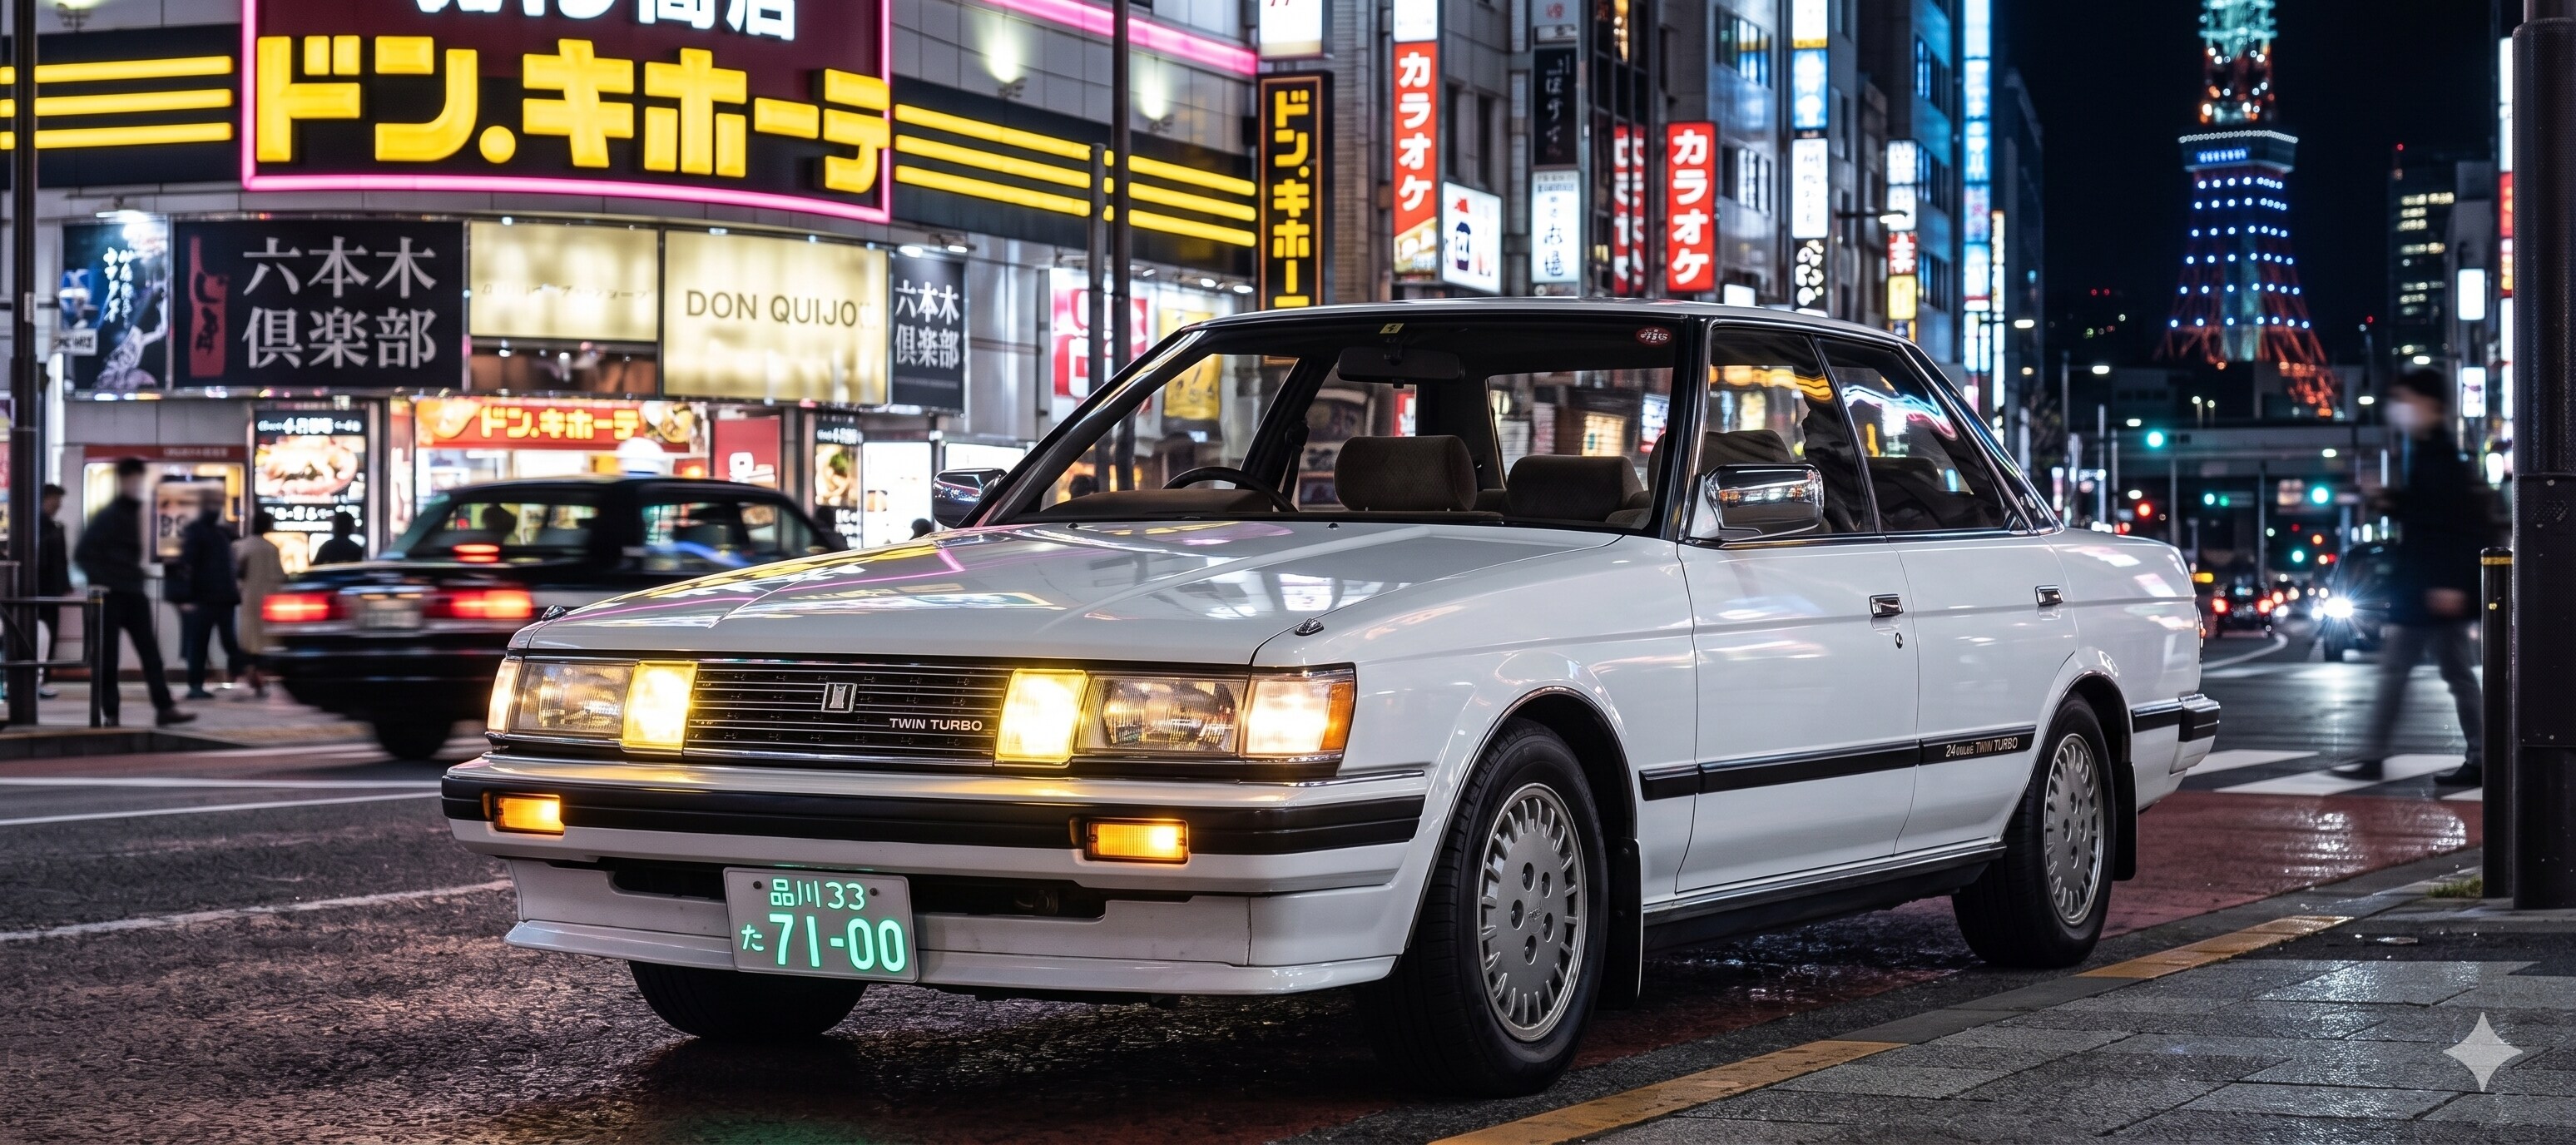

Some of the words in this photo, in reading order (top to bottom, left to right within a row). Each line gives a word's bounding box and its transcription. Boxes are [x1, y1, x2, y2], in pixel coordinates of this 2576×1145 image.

[1399, 52, 1433, 211] カラオケ
[1672, 129, 1710, 285] カラオケ
[242, 236, 437, 299] 六本木
[687, 290, 756, 320] DON
[894, 280, 960, 325] 六本木
[242, 306, 437, 369] 倶楽部
[889, 717, 926, 730] TWIN
[929, 719, 983, 731] TURBO
[1994, 736, 2019, 752] TURBO
[770, 878, 821, 909] 品川
[825, 881, 866, 911] 33
[741, 924, 765, 951] た
[769, 913, 906, 973] 71-00
